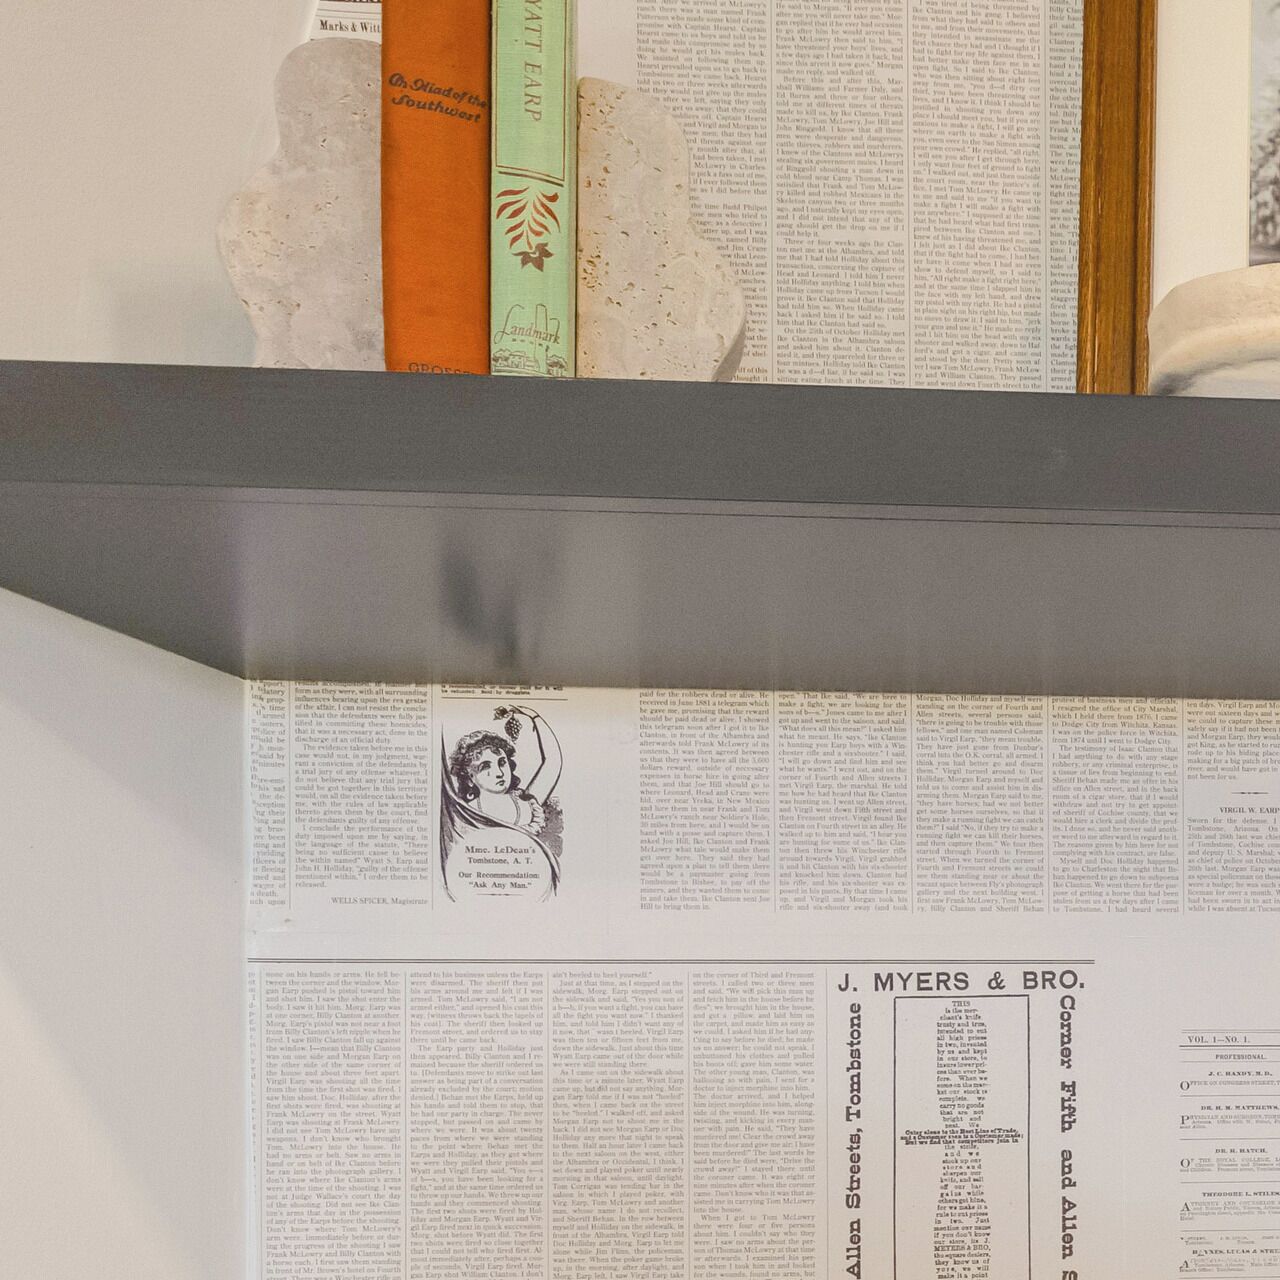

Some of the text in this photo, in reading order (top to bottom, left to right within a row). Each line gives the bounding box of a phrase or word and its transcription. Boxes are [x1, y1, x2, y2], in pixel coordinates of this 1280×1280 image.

[320, 20, 349, 32] Marks
[389, 73, 487, 108] An Iliad of the
[392, 94, 481, 122] Southwest
[524, 61, 542, 122] EARP
[494, 304, 560, 344] Landmark
[838, 970, 1084, 992] J. MYERS & BRO.
[1059, 995, 1076, 1069] Corner
[845, 1002, 862, 1122] Tombstone
[1060, 1080, 1077, 1133] Fifth
[845, 1128, 863, 1209] Streets,
[1061, 1149, 1077, 1190] and
[846, 1218, 861, 1280] Allen
[1061, 1196, 1077, 1260] Allen
